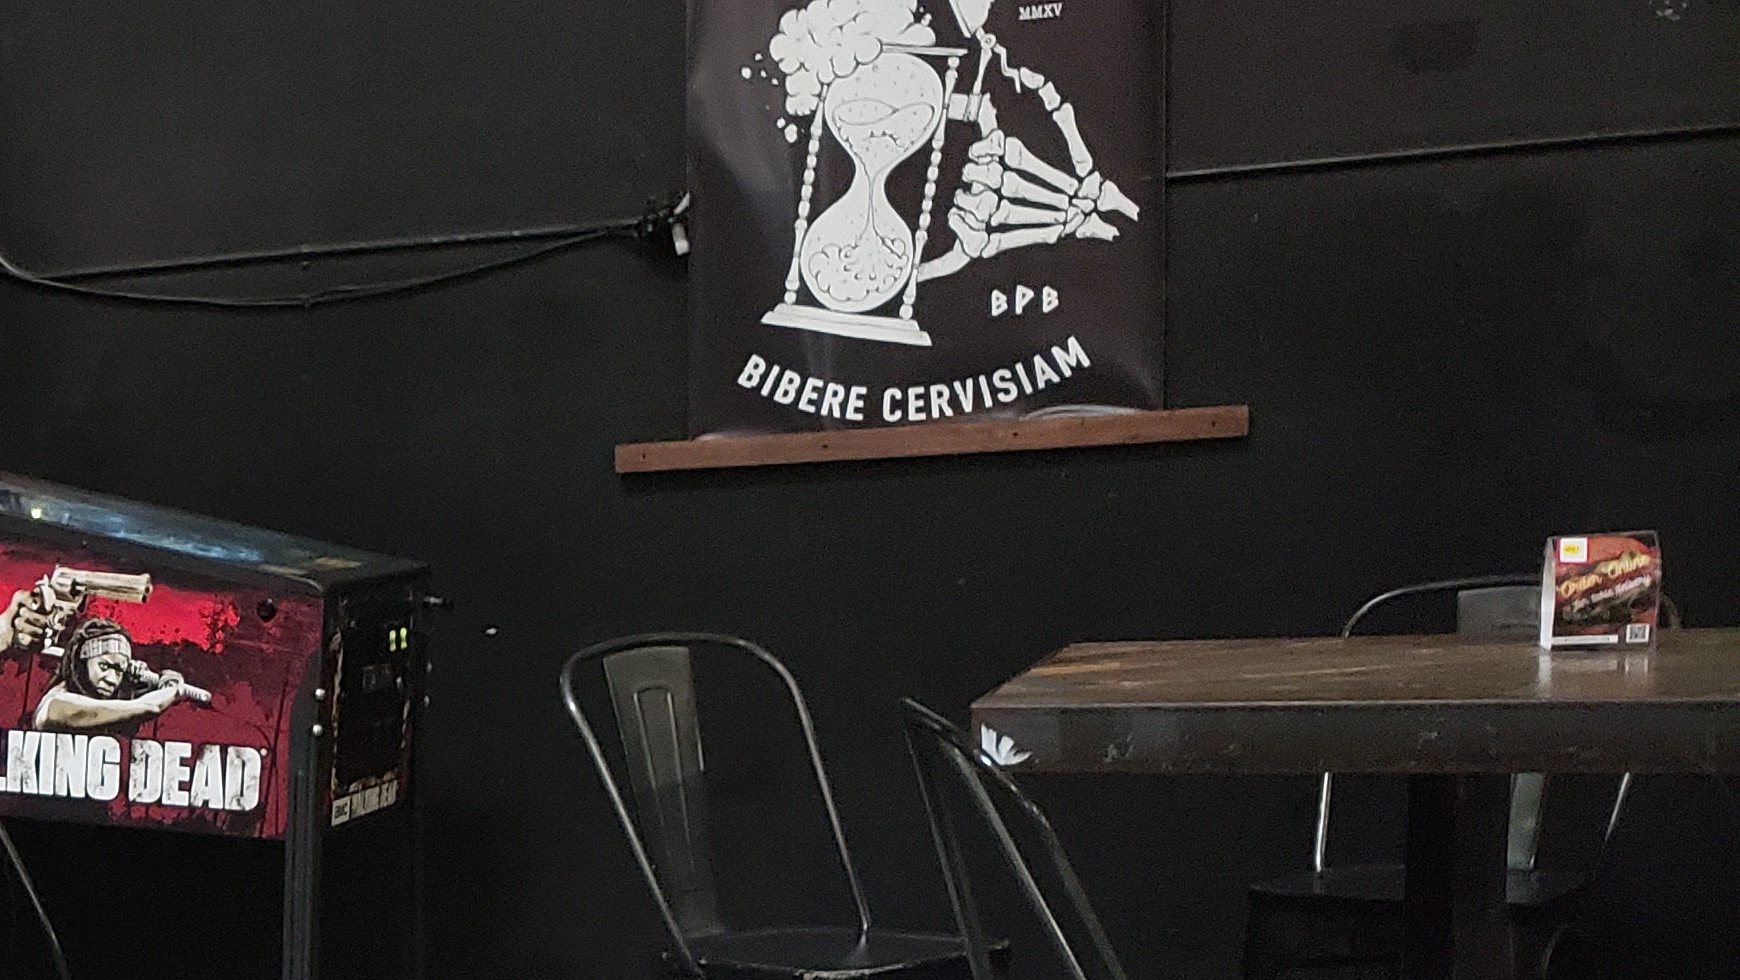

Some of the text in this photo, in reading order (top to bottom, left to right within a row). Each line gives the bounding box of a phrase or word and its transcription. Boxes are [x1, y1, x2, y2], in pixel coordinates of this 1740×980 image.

[1018, 2, 1063, 21] MMXV
[737, 335, 1092, 423] BIBERE CERVISIAM
[128, 737, 262, 812] DEAD
